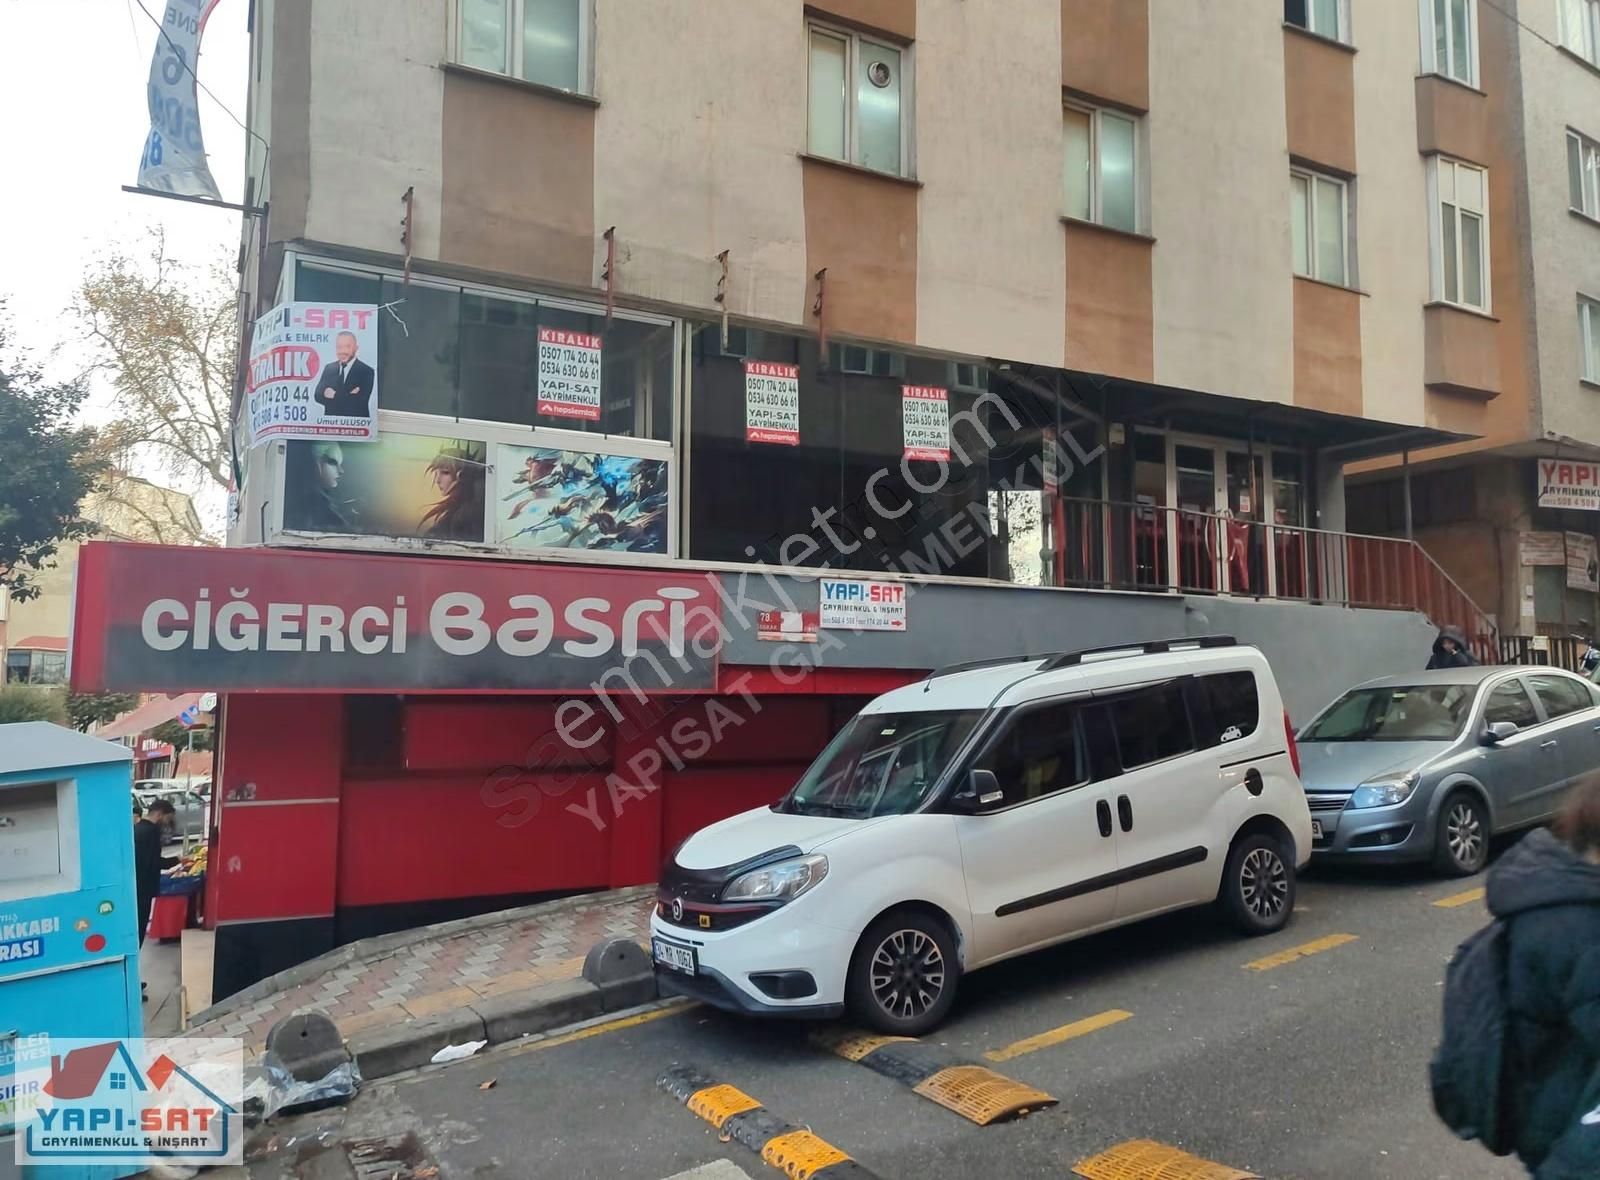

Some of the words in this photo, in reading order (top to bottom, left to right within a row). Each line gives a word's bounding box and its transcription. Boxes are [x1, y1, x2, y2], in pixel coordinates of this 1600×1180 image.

[296, 333, 329, 342] EMLAK
[541, 330, 600, 348] KIRALIK
[541, 346, 561, 360] 0507
[563, 349, 575, 362] 174
[578, 351, 588, 364] 20
[589, 353, 599, 366] 44
[541, 361, 561, 375] 0534
[562, 364, 578, 377] 630
[579, 366, 589, 379] 66
[591, 368, 599, 381] 61
[747, 362, 797, 378] KIRALIK
[275, 386, 288, 402] 20
[293, 386, 310, 402] 44
[541, 379, 599, 394] YAPI-SAT
[748, 378, 765, 391] 0507
[767, 380, 777, 392] 174
[778, 381, 787, 393] 20
[789, 382, 797, 394] 44
[903, 386, 947, 399] KIRALIK
[748, 391, 765, 404] 0534
[767, 393, 779, 406] 630
[780, 395, 789, 407] 66
[790, 396, 797, 409] 61
[904, 401, 919, 412] 0507
[920, 402, 930, 413] 174
[931, 403, 939, 414] 20
[940, 403, 947, 414] 44
[284, 405, 308, 421] 508
[749, 409, 797, 421] YAPI-SAT
[905, 413, 920, 426] 0534
[921, 414, 932, 425] 630
[317, 417, 339, 425] Umut
[340, 418, 372, 427] ULUSOY
[905, 429, 948, 440] YAPI-SAT
[823, 582, 904, 603] YAPI-SAT
[141, 587, 408, 655] CİĞERCİ
[0, 916, 60, 941] KKABI
